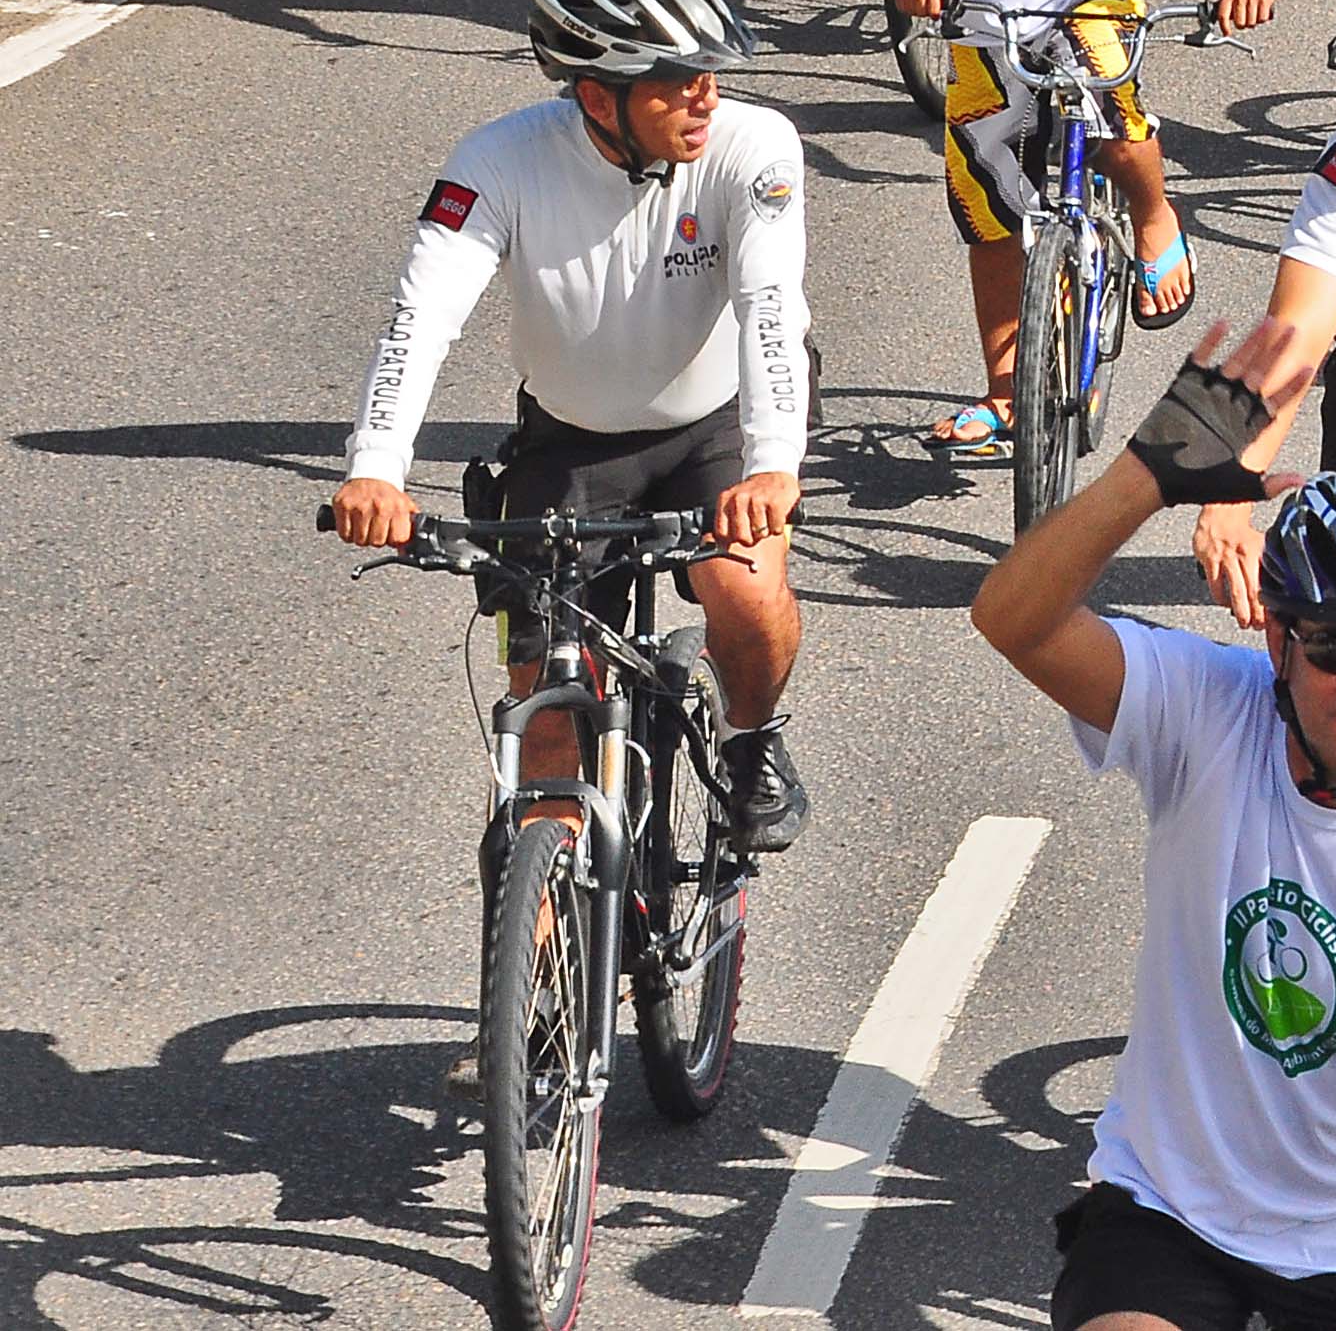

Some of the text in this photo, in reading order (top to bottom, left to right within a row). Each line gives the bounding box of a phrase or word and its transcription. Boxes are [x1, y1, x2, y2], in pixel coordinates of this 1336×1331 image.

[369, 299, 416, 432] ICLO PATRULHA
[766, 363, 796, 414] CICLO
[1233, 913, 1247, 930] II
[1246, 883, 1298, 919] Paeio
